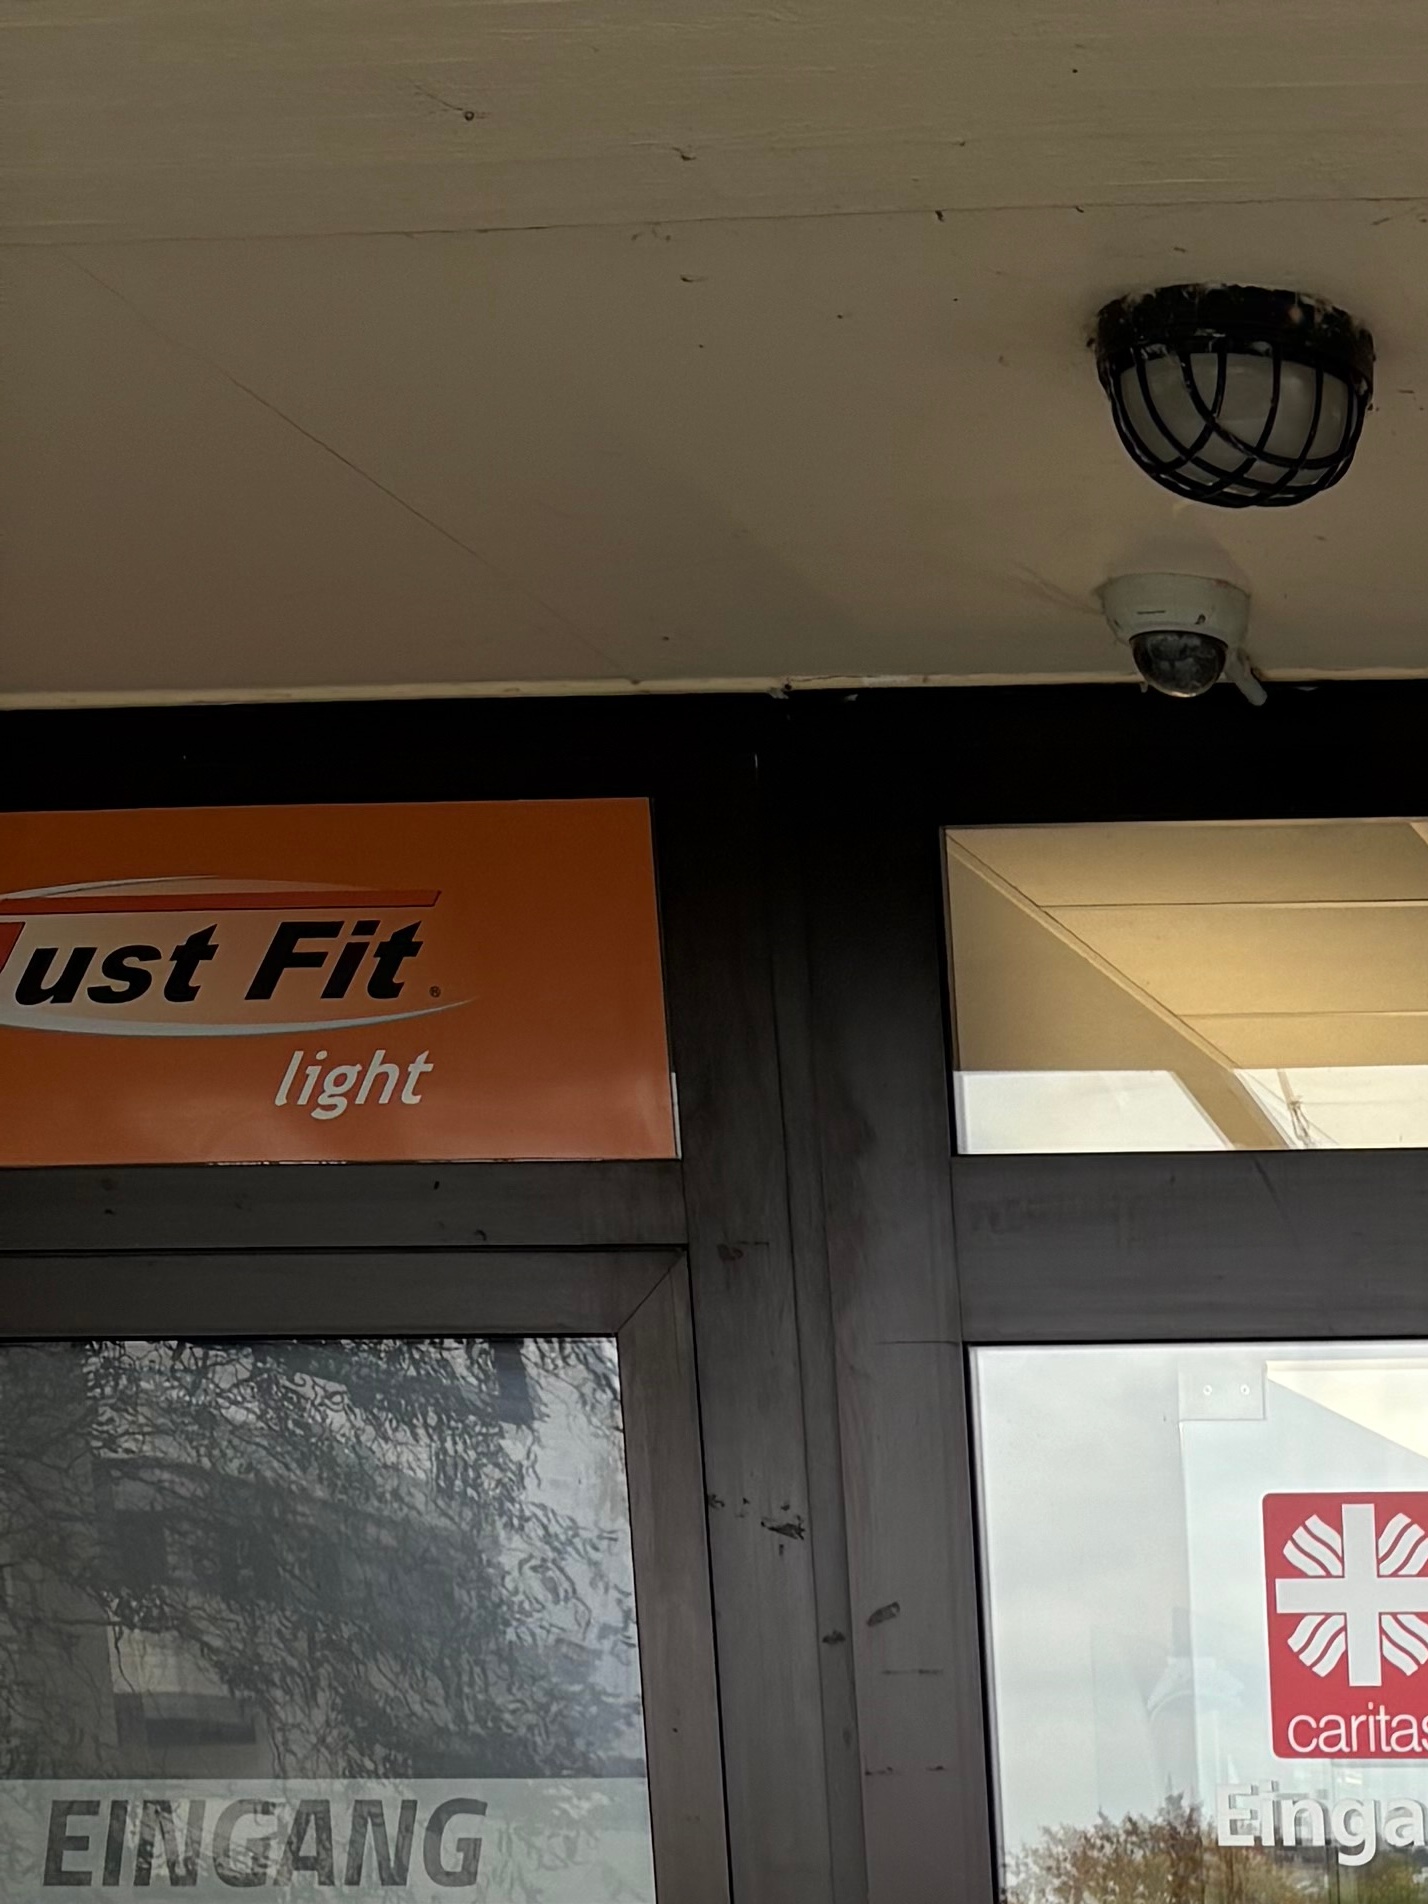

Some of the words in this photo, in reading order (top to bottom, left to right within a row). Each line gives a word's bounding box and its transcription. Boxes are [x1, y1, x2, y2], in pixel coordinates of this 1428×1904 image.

[0, 921, 220, 1006] ust
[244, 919, 423, 1002] Fit
[274, 1049, 434, 1121] light
[42, 1798, 488, 1888] EINGANG
